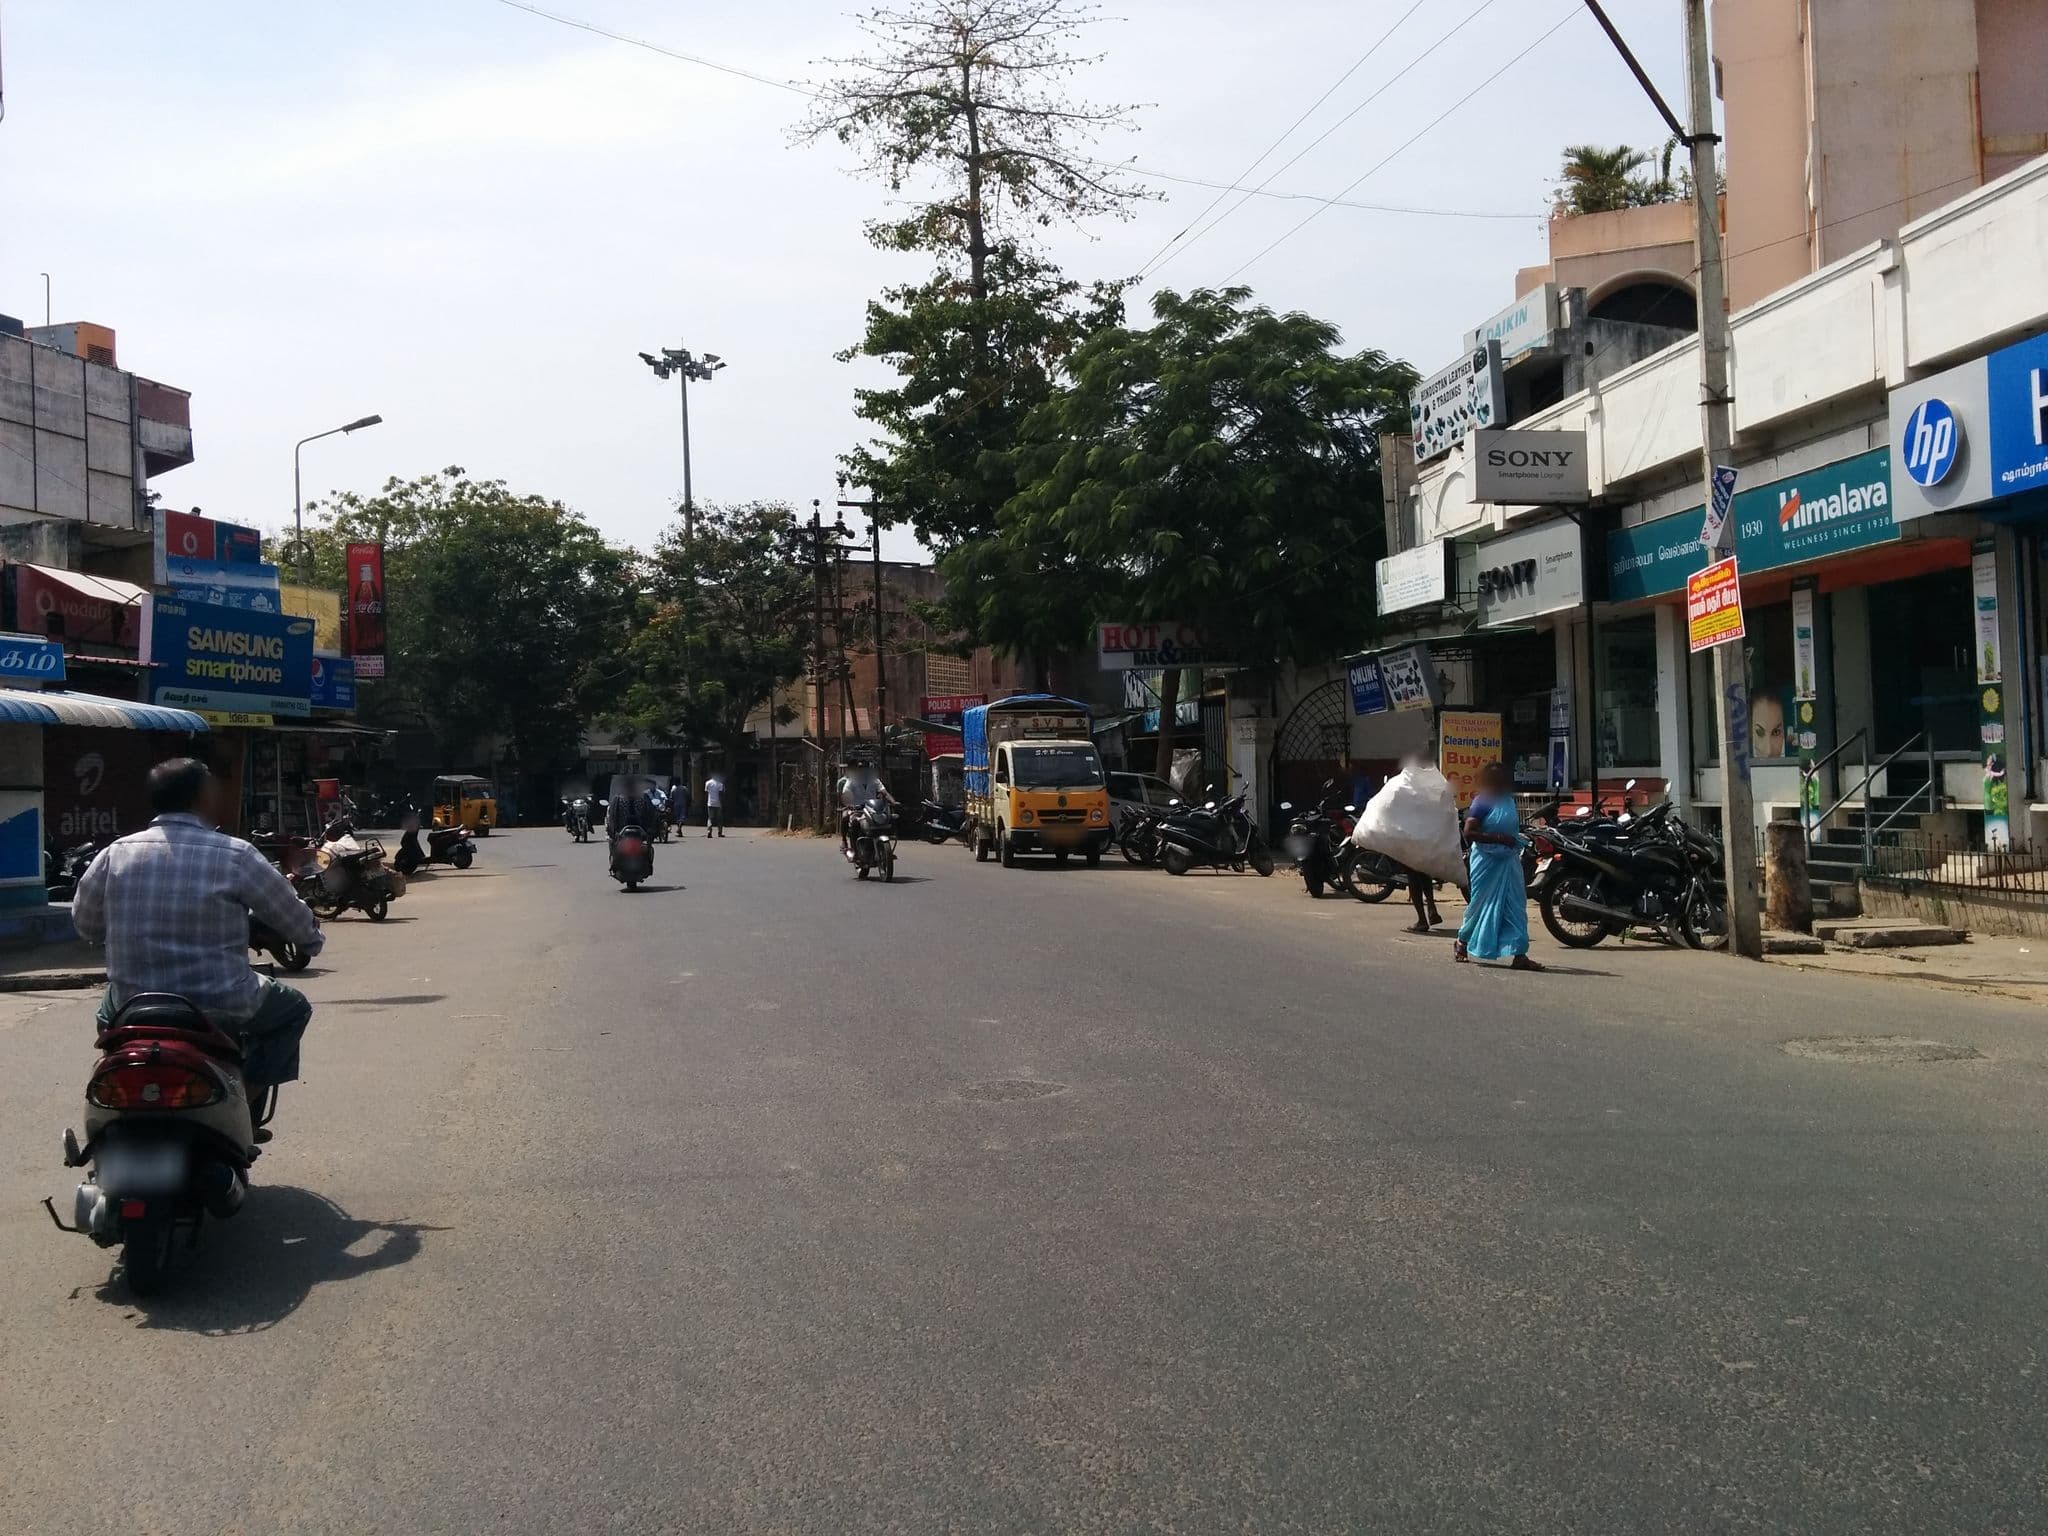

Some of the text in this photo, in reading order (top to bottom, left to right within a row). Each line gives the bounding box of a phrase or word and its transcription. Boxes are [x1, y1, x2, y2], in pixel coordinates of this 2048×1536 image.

[1448, 361, 1472, 384] LEATHER
[1909, 402, 1953, 486] hp
[1487, 449, 1574, 467] SONY
[1498, 471, 1539, 480] Smartphone
[1779, 481, 1888, 532] Himalaya
[1741, 520, 1763, 539] 1930
[1783, 516, 1890, 550] WELLNESS SINCE 1930
[187, 626, 284, 660] SAMSUNG
[1103, 624, 1161, 650] HOT
[186, 658, 282, 684] smartphone
[1350, 663, 1378, 686] ONLINE
[928, 699, 951, 710] POLICE
[1443, 735, 1501, 748] Clearing Sale
[61, 805, 120, 835] airtel
